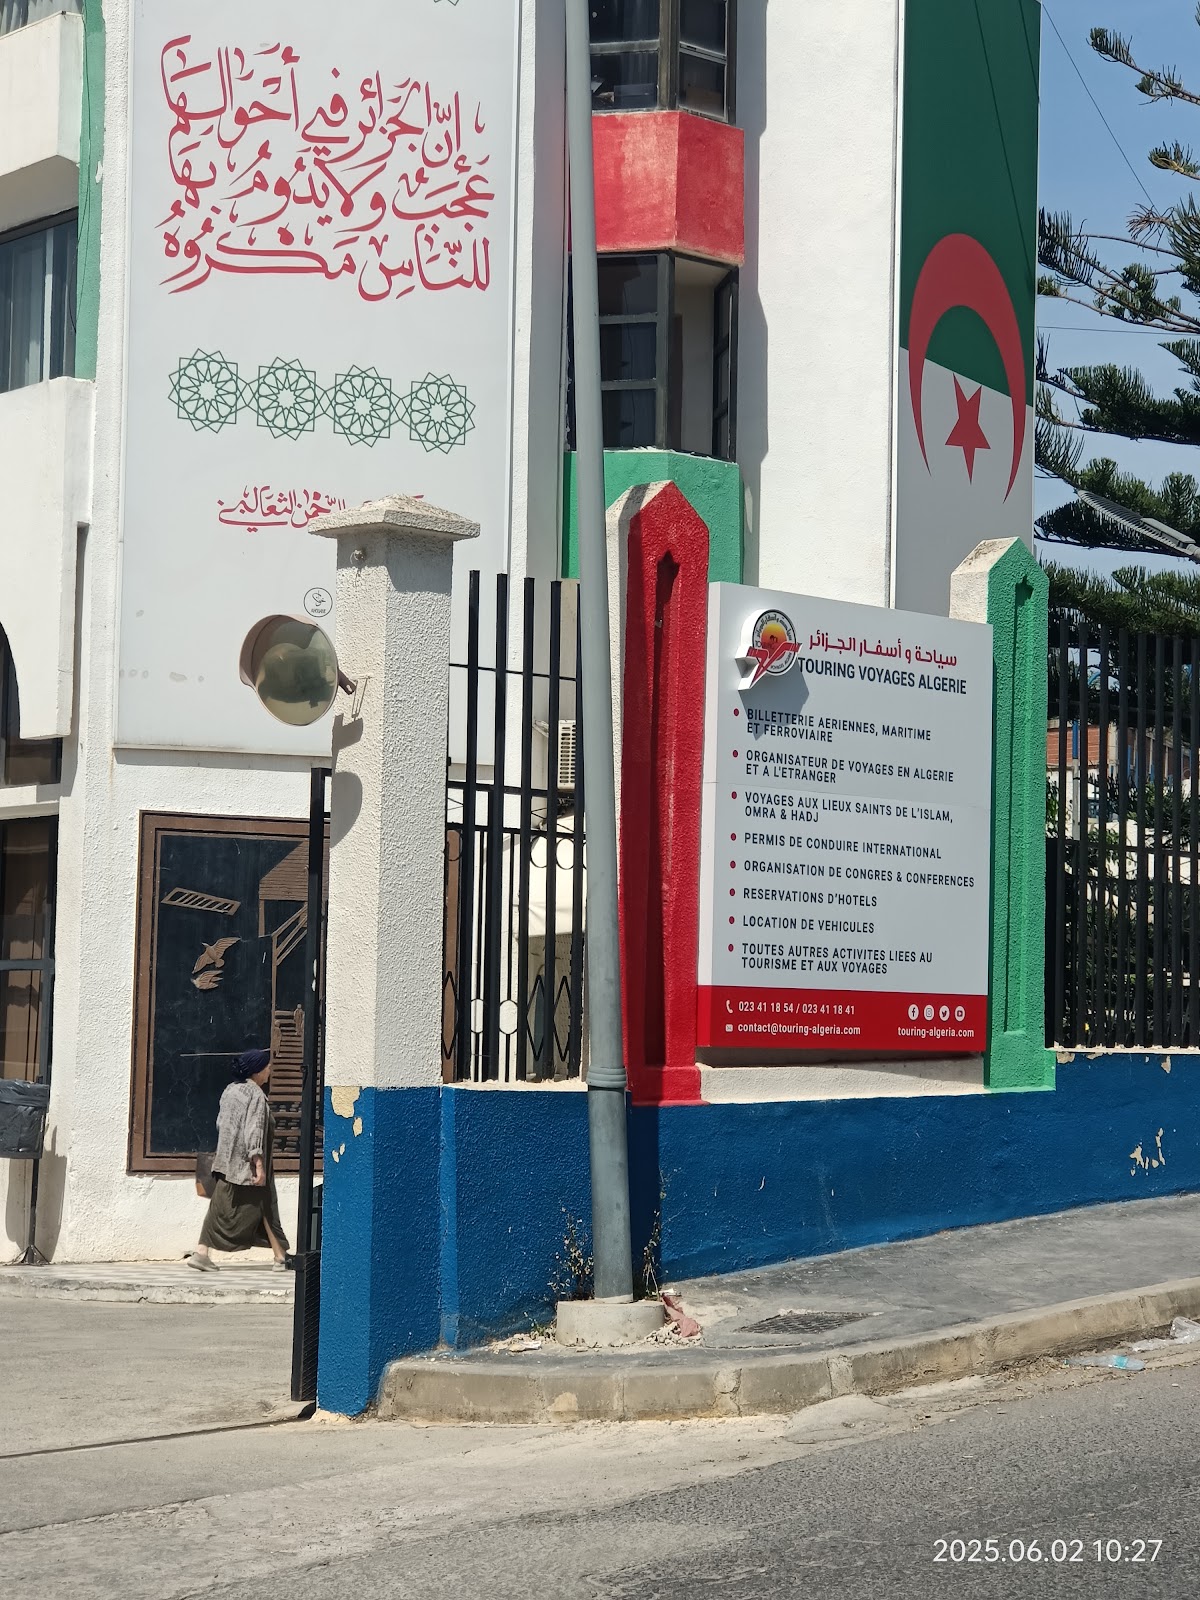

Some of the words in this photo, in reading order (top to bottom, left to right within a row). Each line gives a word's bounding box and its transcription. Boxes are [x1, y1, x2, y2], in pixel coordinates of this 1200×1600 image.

[809, 629, 856, 655] الجزائر
[859, 638, 902, 658] أسفار
[905, 649, 912, 664] و
[915, 645, 957, 669] سياحة
[798, 657, 855, 678] TOURING
[858, 666, 915, 687] VOYAGES
[918, 674, 966, 694] ALGERIE
[747, 708, 814, 727] BILLETTERIE
[818, 717, 878, 736] AERIENNES,
[882, 725, 930, 740] MARITIME
[747, 722, 760, 734] ET
[764, 725, 833, 743] FERROVIAIRE
[746, 750, 827, 768] ORGANISATEUR
[832, 759, 844, 770] DE
[848, 760, 893, 776] VOYAGES
[898, 766, 910, 778] EN
[914, 768, 954, 782] ALGERIE
[746, 764, 759, 775] ET
[763, 766, 769, 776] A
[774, 766, 836, 783] L'ETRANGER
[745, 792, 794, 807] VOYAGES
[798, 797, 818, 809] AUX
[823, 799, 851, 812] LIEUX
[856, 802, 891, 816] SAINTS
[896, 806, 907, 817] DE
[912, 808, 952, 823] L'ISLAM,
[745, 806, 776, 819] OMRA
[780, 809, 786, 820] &
[791, 810, 818, 822] HADJ
[745, 832, 785, 846] PERMIS
[790, 836, 802, 848] DE
[806, 838, 858, 852] CONDUIRE
[863, 842, 941, 859] INTERNATIONAL
[744, 860, 824, 876] ORGANISATION
[829, 866, 841, 878] DE
[846, 868, 892, 881] CONGRES
[896, 872, 902, 882] &
[906, 872, 974, 887] CONFERENCES
[744, 888, 823, 903] RESERVATIONS
[828, 893, 877, 906] D'HOTELS
[743, 915, 796, 929] LOCATION
[801, 919, 814, 930] DE
[818, 920, 874, 933] VEHICULES
[742, 943, 784, 956] TOUTES
[788, 946, 828, 958] AUTRES
[832, 948, 885, 960] ACTIVITES
[890, 950, 916, 962] LIEES
[920, 952, 932, 962] AU
[742, 957, 796, 970] TOURISME
[801, 960, 814, 971] ET
[817, 960, 838, 972] AUX
[842, 962, 887, 974] VOYAGES
[739, 1001, 754, 1011] 023
[757, 1002, 766, 1012] 41
[771, 1002, 780, 1012] 18
[784, 1003, 793, 1012] 54
[796, 1004, 800, 1013] /
[802, 1004, 817, 1013] 023
[820, 1004, 829, 1014] 41
[833, 1005, 842, 1014] 18
[845, 1005, 854, 1014] 41
[738, 1023, 860, 1036] contact@touring-algeria.com
[898, 1026, 974, 1038] touring-algeria.com
